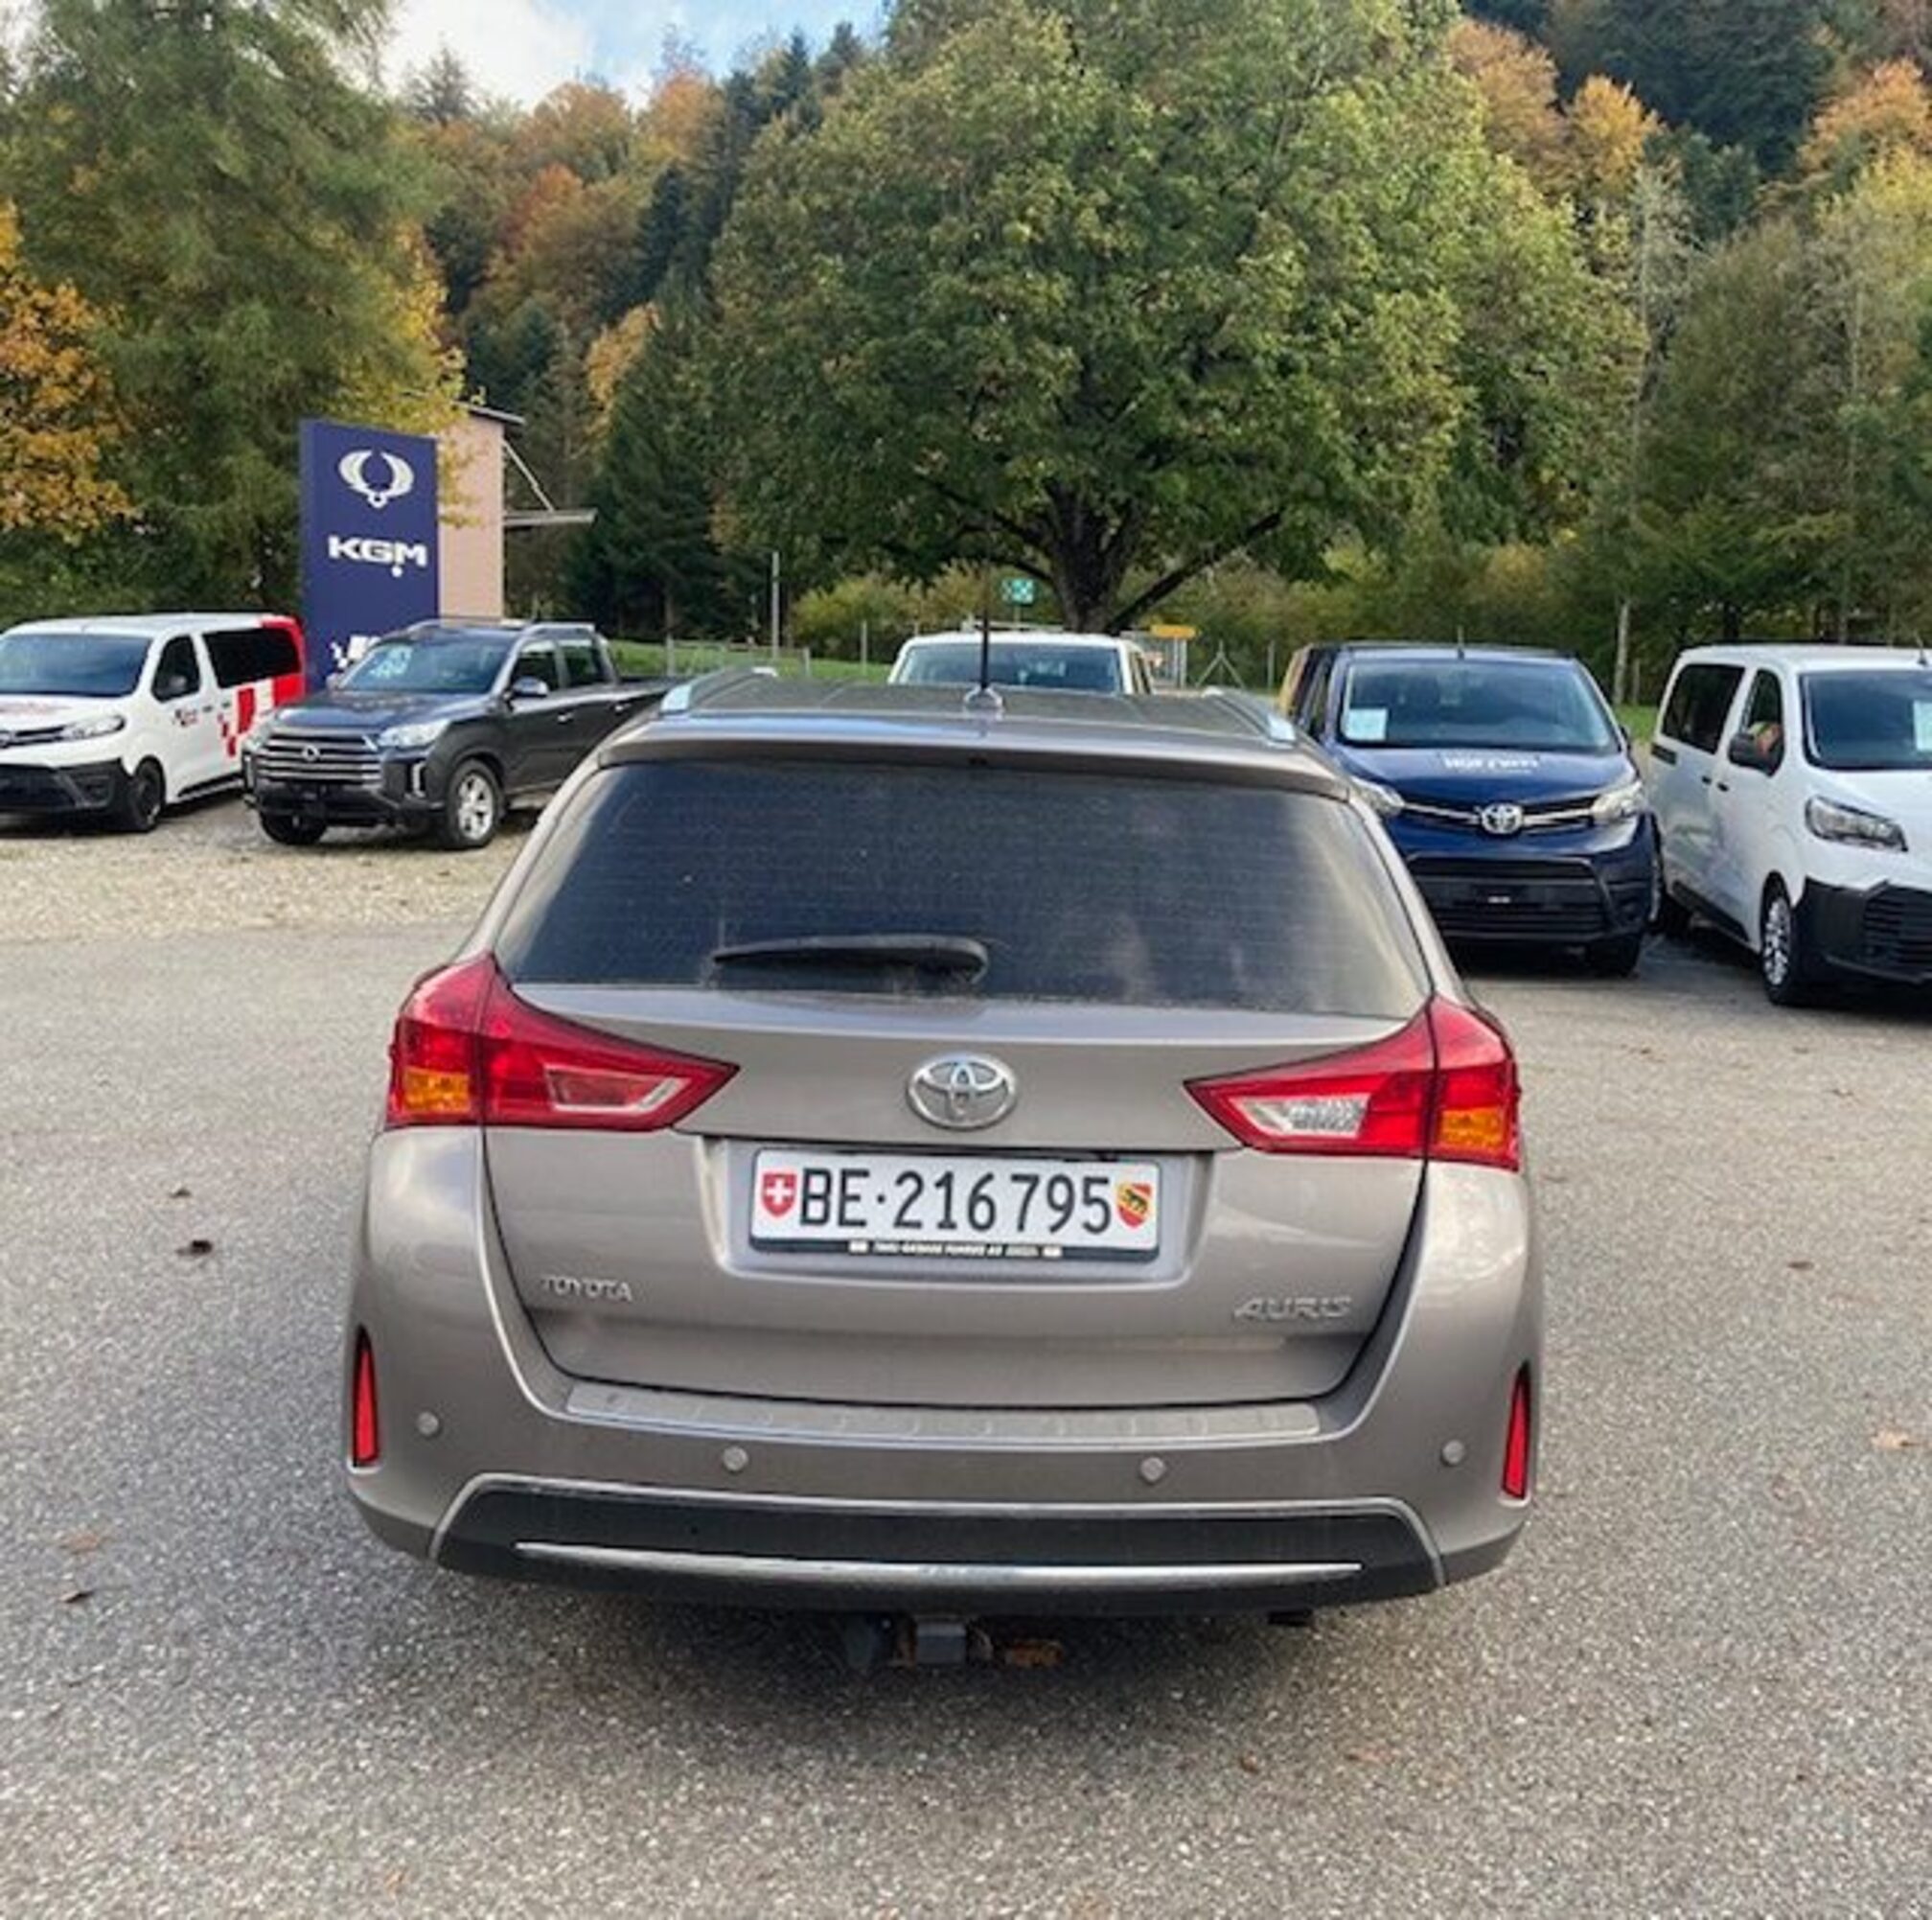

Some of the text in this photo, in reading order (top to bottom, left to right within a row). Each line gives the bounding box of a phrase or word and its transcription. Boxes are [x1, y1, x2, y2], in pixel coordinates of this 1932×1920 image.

[328, 534, 428, 569] KGM
[540, 1275, 632, 1303] TOYOTA
[1233, 1296, 1352, 1320] AURIS
